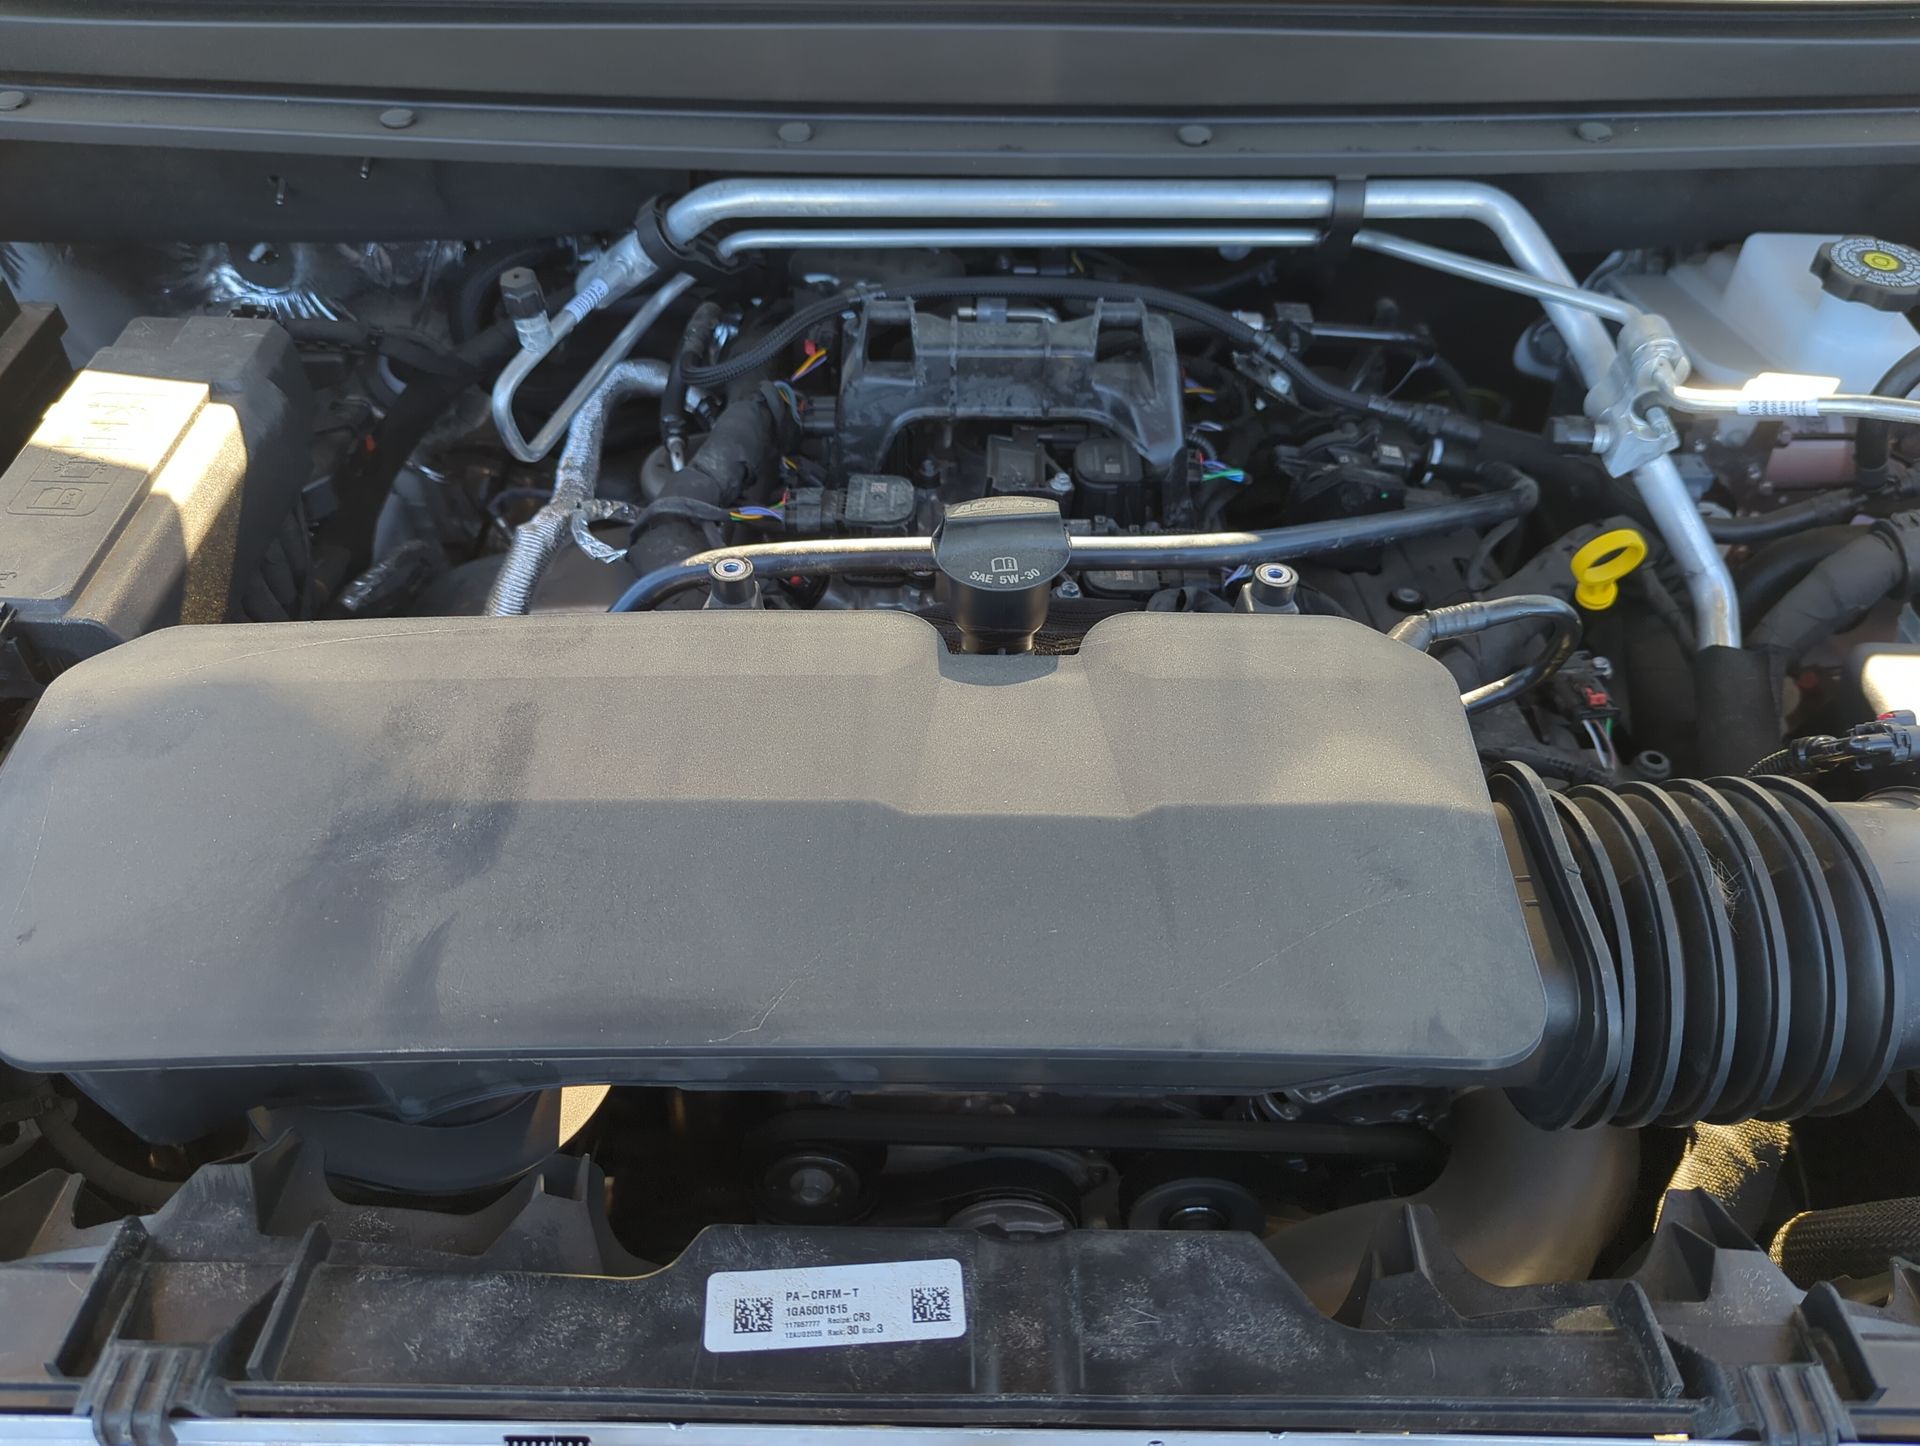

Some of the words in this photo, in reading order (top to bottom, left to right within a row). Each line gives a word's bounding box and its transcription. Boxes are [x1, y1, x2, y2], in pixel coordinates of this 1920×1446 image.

[969, 570, 994, 584] SAE
[999, 568, 1041, 585] 5W-30
[786, 1288, 859, 1301] PA-CRFM-T
[785, 1304, 848, 1317] 1GA5001615
[853, 1312, 871, 1322] CR3
[847, 1325, 859, 1335] 30
[876, 1323, 884, 1333] 3
